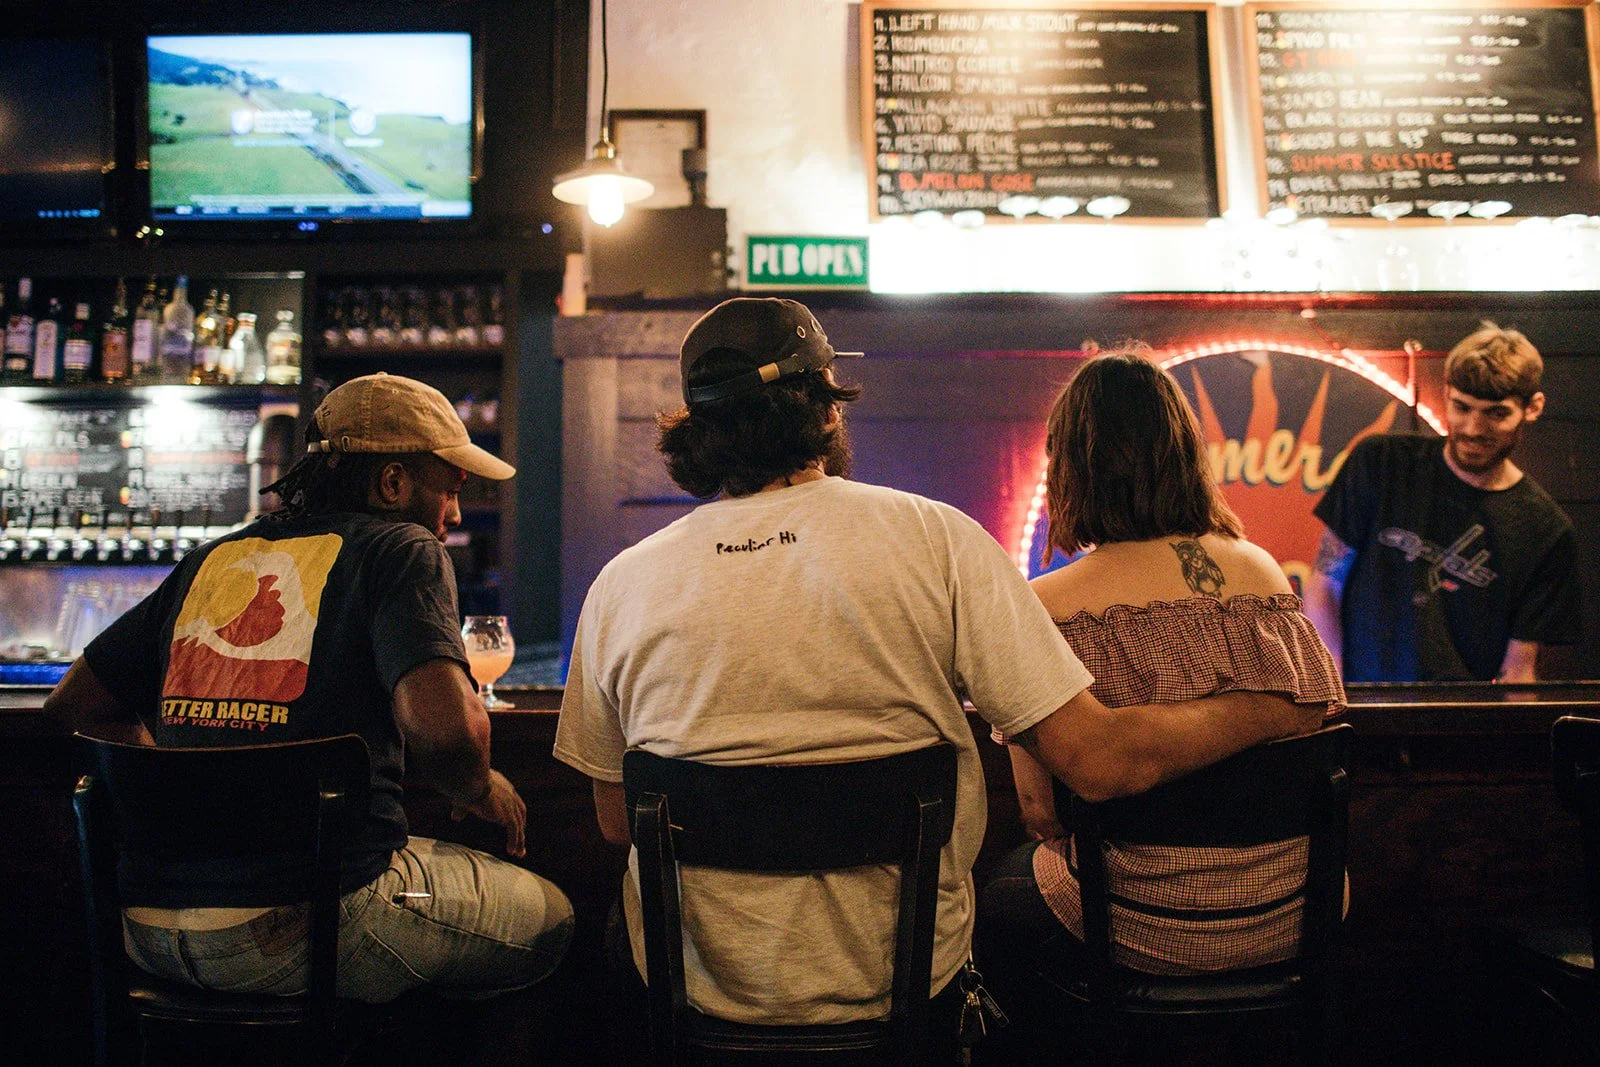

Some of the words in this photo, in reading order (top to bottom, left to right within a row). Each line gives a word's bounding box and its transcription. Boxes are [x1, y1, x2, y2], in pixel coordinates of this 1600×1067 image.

[889, 14, 936, 31] LEFT
[1024, 13, 1080, 32] STOUT
[1291, 154, 1365, 172] SUMMER
[1370, 151, 1456, 172] SOLSTICE
[752, 243, 800, 276] PUB
[801, 243, 863, 276] OPEN
[716, 537, 775, 555] Peculiar
[779, 530, 797, 545] Hi
[161, 699, 215, 719] ETTER
[216, 701, 290, 724] RACER
[191, 717, 227, 729] YORK
[229, 719, 269, 732] CITY
